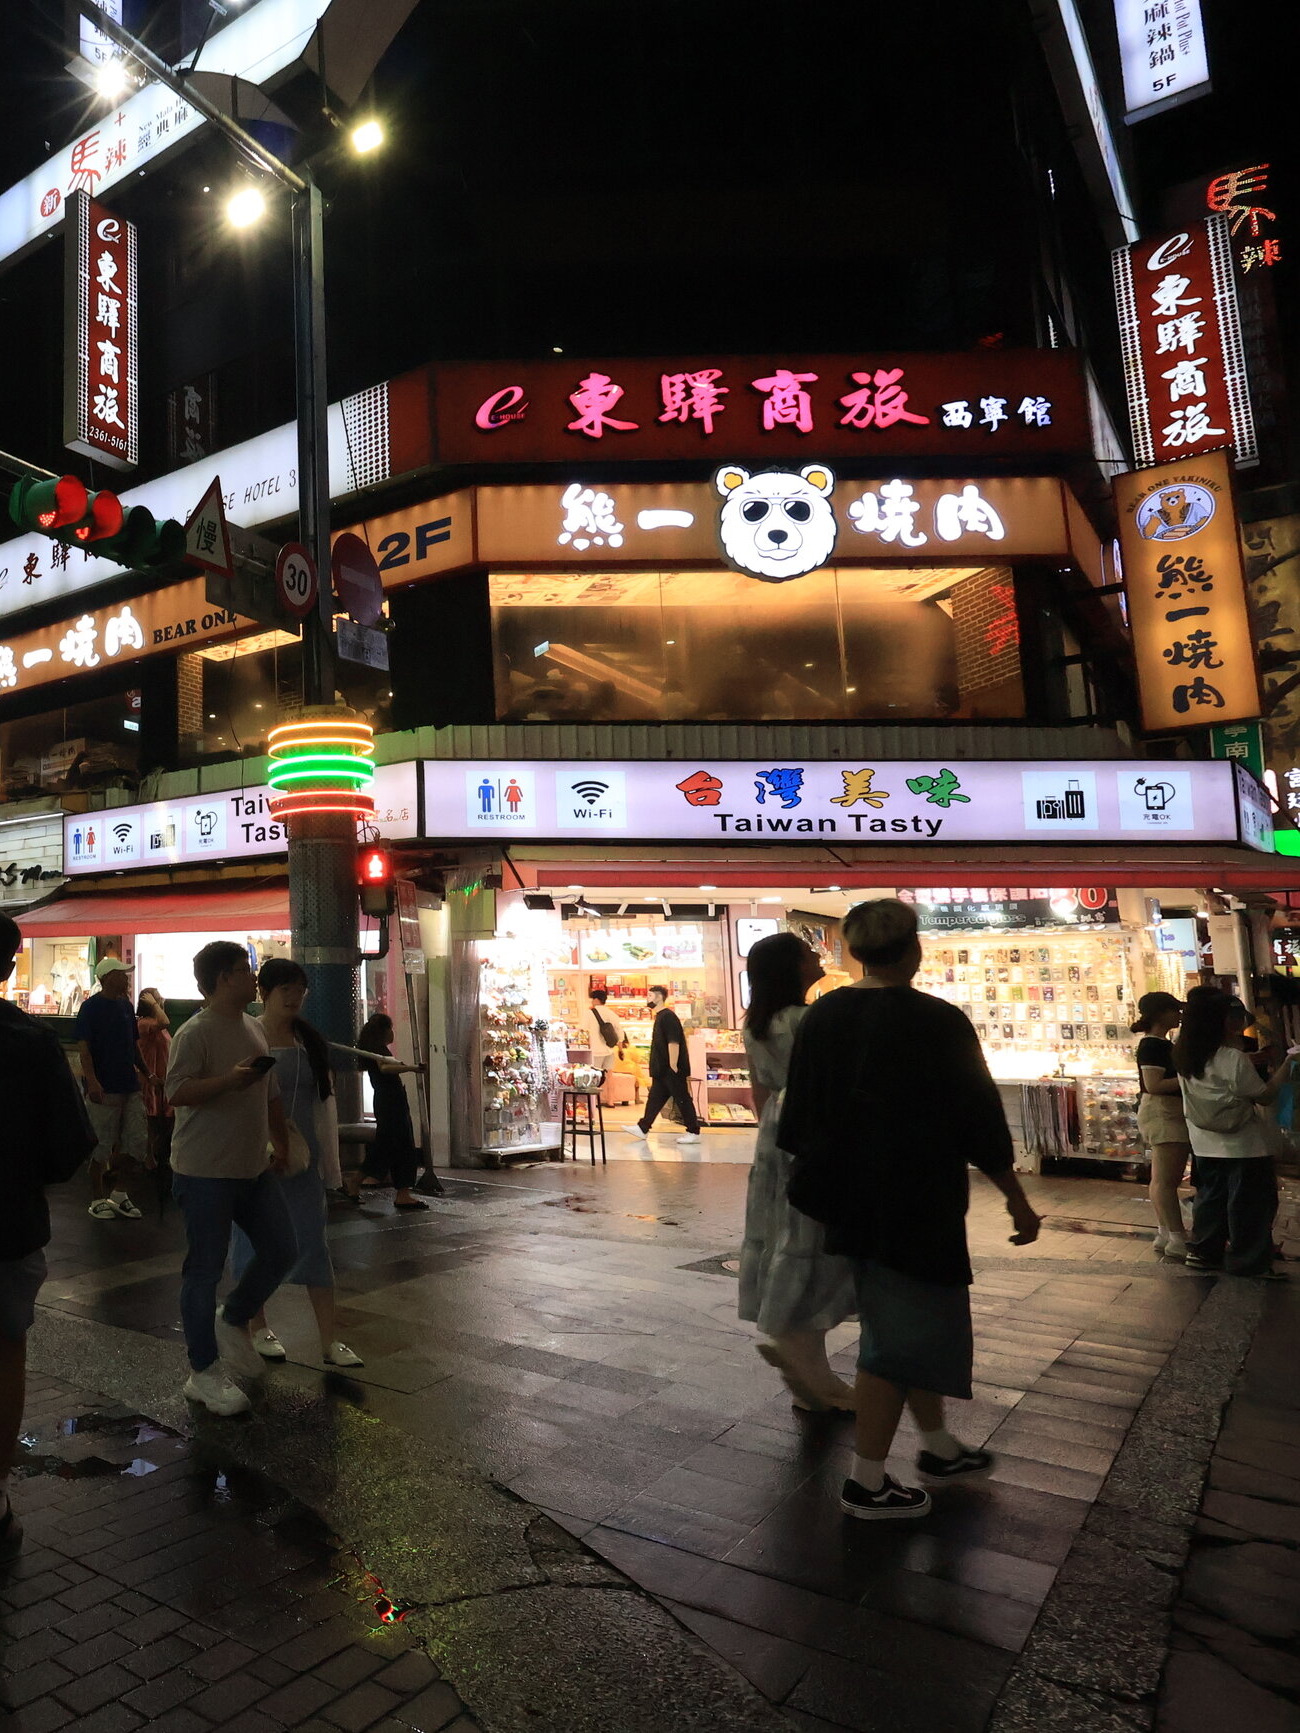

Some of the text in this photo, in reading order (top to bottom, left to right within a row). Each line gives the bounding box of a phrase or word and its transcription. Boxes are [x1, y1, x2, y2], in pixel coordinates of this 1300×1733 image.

[1143, 0, 1175, 69] 麻辣鍋
[1153, 73, 1177, 92] 5F
[43, 191, 58, 215] 新
[93, 250, 126, 429] 東驛商旅
[1151, 274, 1226, 448] 東驛商旅
[567, 368, 929, 438] 東驛商旅
[89, 425, 127, 451] 2361-5161
[244, 475, 280, 504] HOTEL
[1147, 479, 1170, 492] ONE
[557, 482, 694, 552] 熊一
[197, 517, 217, 555] 慢
[377, 517, 451, 571] 2F
[22, 543, 92, 585] 東驛
[285, 563, 308, 597] 30
[153, 619, 197, 645] BEAR
[675, 767, 971, 810] 台灣美味
[573, 808, 613, 820] Wi-Fi
[713, 813, 943, 838] Taiwan Tasty
[113, 846, 133, 854] Wi-Fi
[920, 914, 986, 927] Tempered
